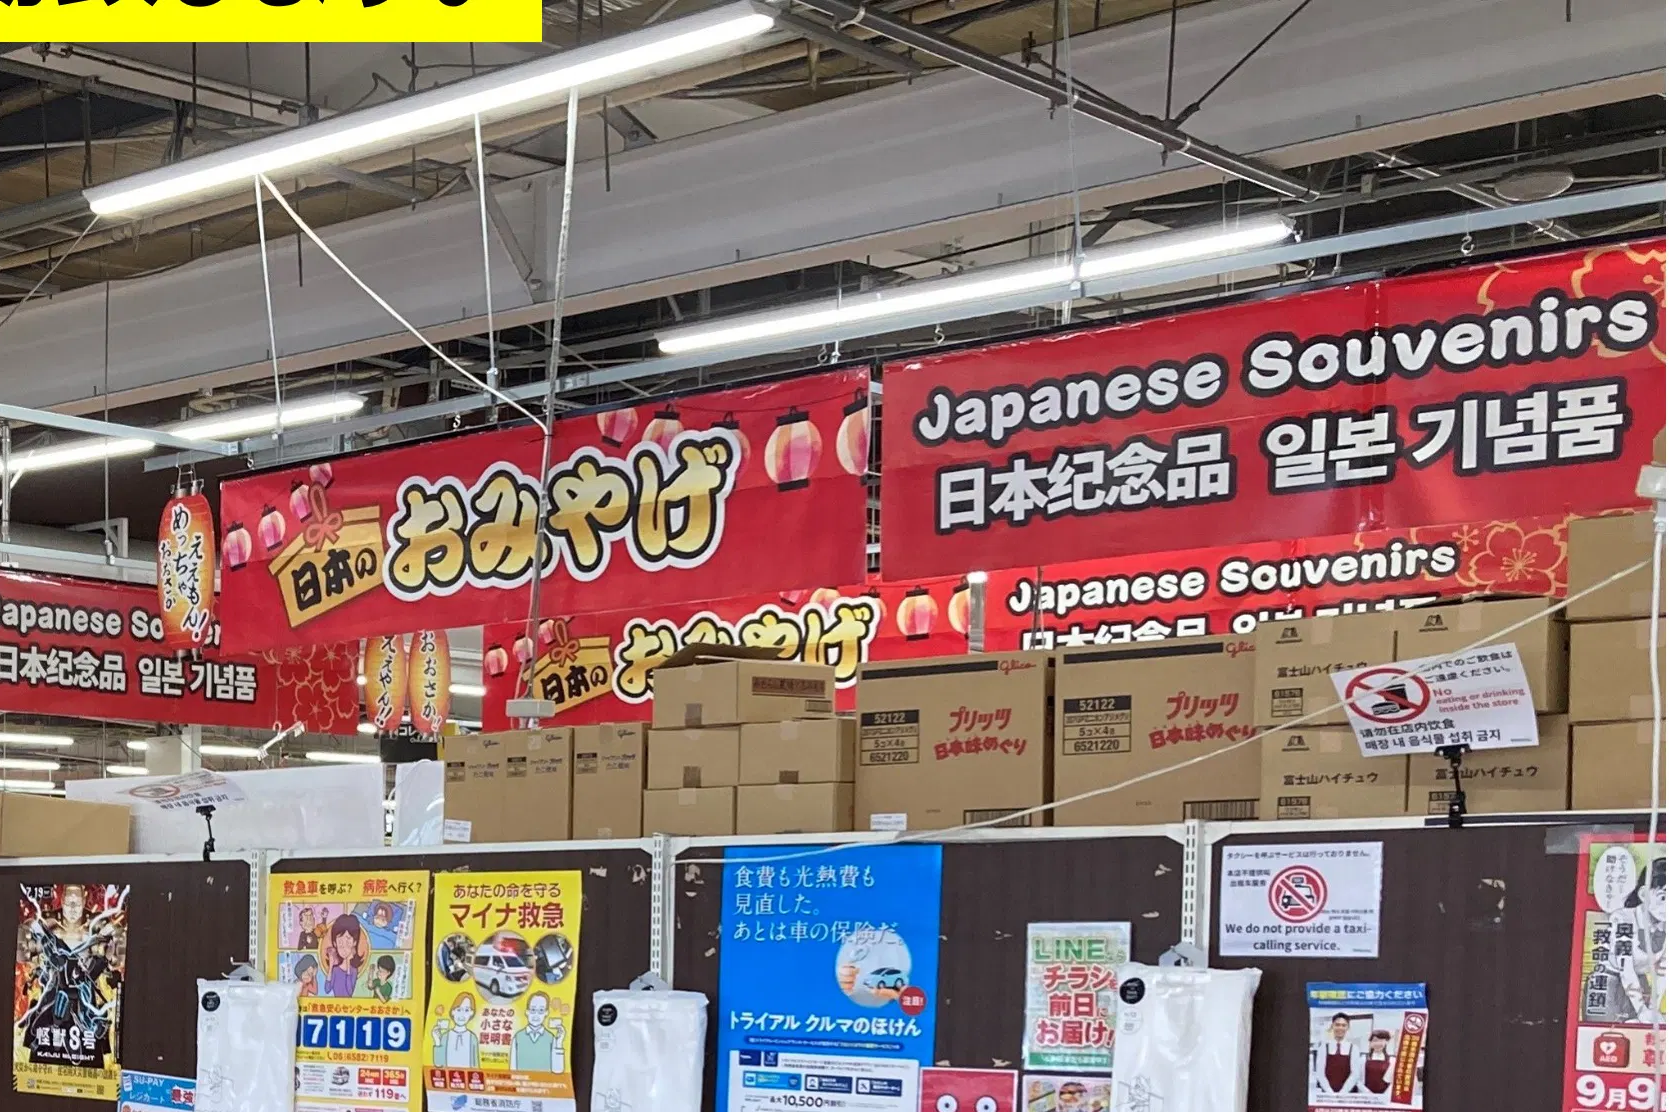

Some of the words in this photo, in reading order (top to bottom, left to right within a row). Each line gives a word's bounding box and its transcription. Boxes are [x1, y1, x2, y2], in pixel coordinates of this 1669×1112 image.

[918, 361, 1221, 444] Japanese
[1249, 297, 1649, 389] Souvenirs
[1267, 416, 1396, 489] 일본
[1413, 382, 1625, 470] 기념품
[937, 433, 1230, 531] 日本纪念品
[294, 547, 376, 612] 日本の
[390, 437, 731, 593] おみやげ
[1009, 570, 1206, 618] Japanese
[1221, 542, 1457, 593] Souvenirs
[1226, 643, 1256, 657] Glic
[1000, 660, 1036, 674] Glico
[138, 657, 184, 695] 일본
[189, 663, 257, 701] 기념품
[541, 663, 607, 706] 日本の
[1079, 698, 1115, 710] 52122
[1434, 688, 1452, 697] No
[1436, 694, 1468, 704] eating
[1482, 687, 1525, 699] drinking
[1166, 691, 1239, 720] プリッツ
[1439, 703, 1469, 713] inside
[1472, 702, 1489, 710] the
[1492, 699, 1519, 708] store
[874, 713, 906, 724] 52122
[949, 705, 1012, 732] プリッツ
[1074, 740, 1120, 752] 6521220
[1149, 721, 1257, 750] 日本味めぐり
[1478, 729, 1501, 742] 금지
[870, 751, 909, 763] 6521220
[934, 735, 1027, 761] 日本味めぐり
[1283, 772, 1378, 787] 富士山ハイチュウ
[283, 880, 353, 894] 救急車を呼ぶ?
[363, 880, 422, 895] 病院へ行く?
[734, 865, 874, 888] 食費も光熱費も
[453, 883, 561, 899] あなたの命を守る
[450, 902, 564, 929] マイナ救急
[734, 893, 819, 916] 見直した。
[733, 920, 904, 946] あとは車の保険だ。
[1225, 924, 1242, 934] We
[1245, 923, 1260, 934] do
[1263, 924, 1282, 934] not
[1285, 923, 1330, 936] provide
[1344, 923, 1371, 934] taxi-
[1253, 940, 1292, 952] calling
[1295, 940, 1340, 951] service.
[1616, 922, 1633, 972] 奥義!
[1587, 920, 1613, 1015] 「救命の連鎖」
[482, 1007, 515, 1017] あなたの
[1048, 993, 1108, 1018] 前日に
[308, 1018, 406, 1048] 7119
[481, 1018, 513, 1031] 小さな
[731, 1011, 800, 1030] トライアル
[805, 1014, 921, 1037] クルマのほけん
[1036, 1020, 1115, 1047] お届け!
[36, 1025, 97, 1050] 怪獣8号
[480, 1032, 512, 1046] 説明書
[133, 1075, 164, 1087] SU-PAY
